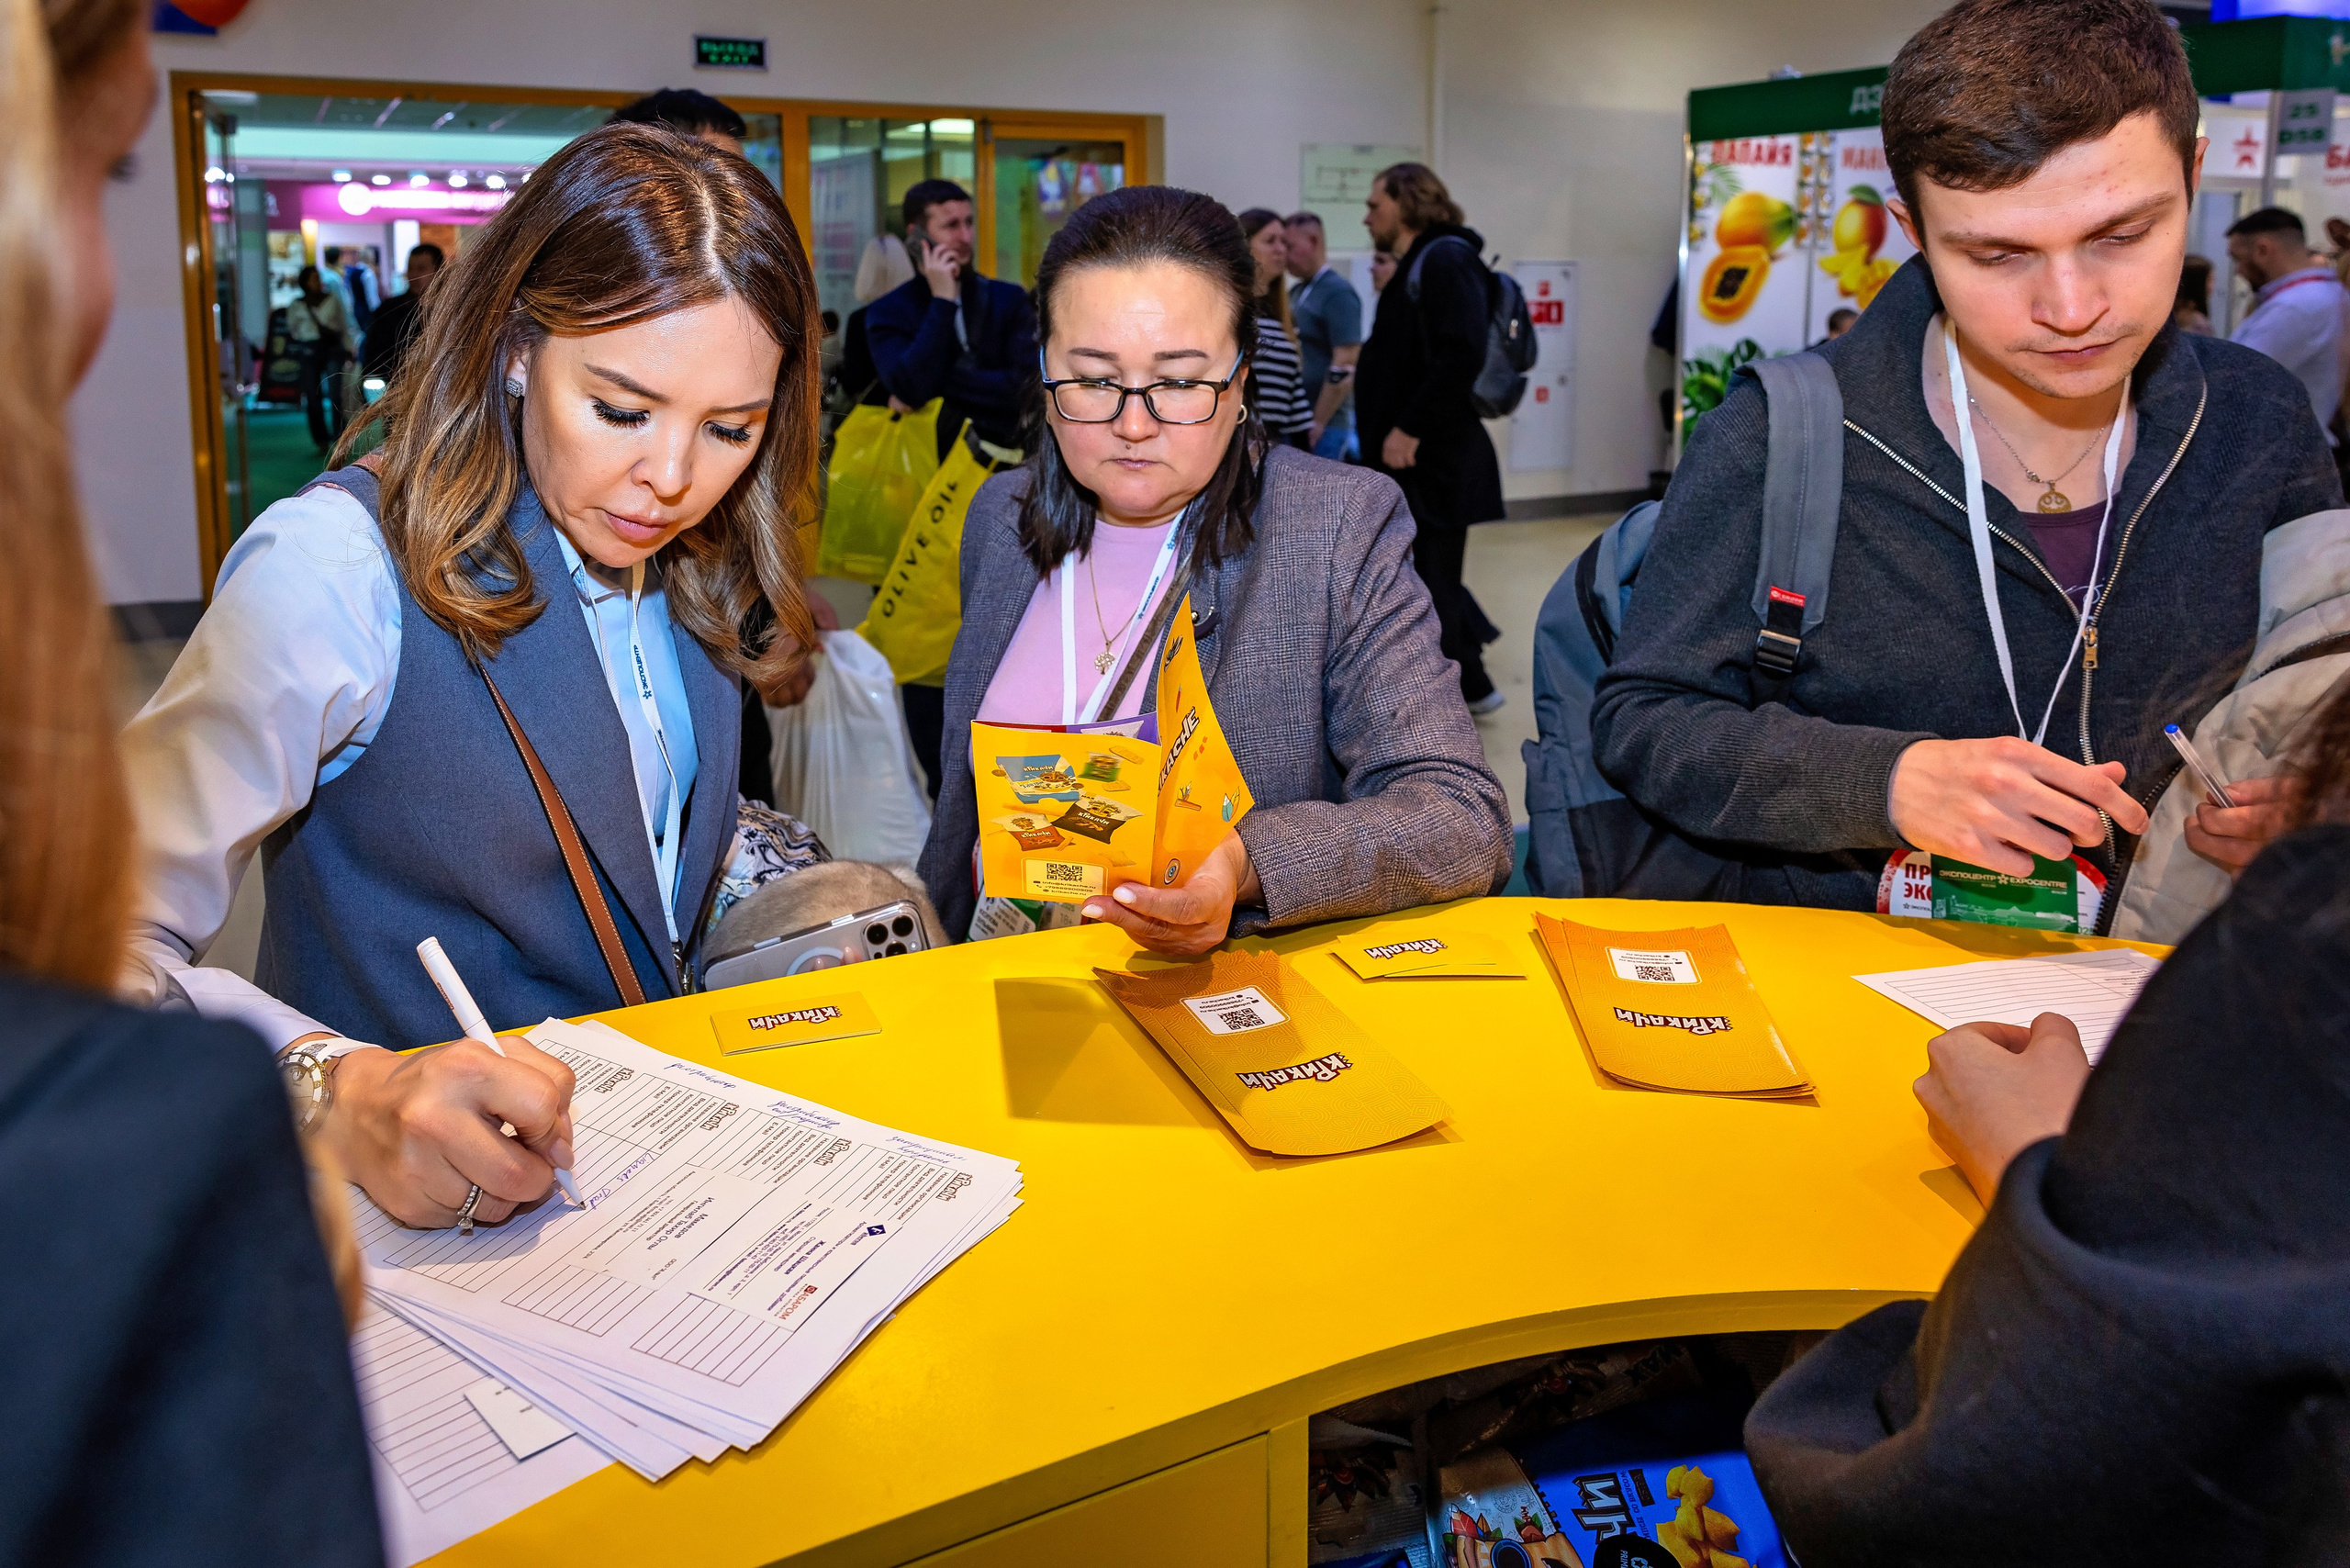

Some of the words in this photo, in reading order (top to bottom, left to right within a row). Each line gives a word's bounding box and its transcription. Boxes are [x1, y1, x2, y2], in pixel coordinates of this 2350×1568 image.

[882, 532, 930, 617] OLIVE
[931, 481, 958, 524] OIL
[633, 644, 649, 689] ЭКСПОЦЕНТР
[1158, 705, 1201, 796] IKACHE
[1939, 870, 1997, 880] ЭКСПОЦЕНТР
[2009, 877, 2067, 889] EXPOCENTRE
[586, 1066, 614, 1085] Название
[652, 1085, 671, 1099] E-Mail
[661, 1090, 682, 1103] Номер
[691, 1097, 707, 1106] Вид
[630, 1103, 665, 1127] телефонные
[662, 1093, 694, 1117] Контактное
[690, 1101, 718, 1122] Название
[648, 1116, 666, 1127] лицо
[657, 1105, 695, 1134] деятельности
[760, 1121, 779, 1135] E-Mail
[656, 1121, 693, 1149] организации
[770, 1126, 791, 1140] Номер
[773, 1129, 804, 1154] Контактное
[802, 1133, 817, 1143] Вид
[741, 1140, 774, 1166] телефонные
[770, 1142, 806, 1170] деятельности
[803, 1137, 830, 1158] Название
[759, 1153, 777, 1165] лицо
[877, 1155, 895, 1169] E-Mail
[889, 1159, 908, 1173] Номер
[771, 1157, 807, 1183] организации
[891, 1163, 922, 1188] Контактное
[921, 1167, 936, 1177] Вид
[861, 1173, 892, 1200] телефонные
[892, 1176, 925, 1205] деятельности
[924, 1171, 950, 1193] Название
[880, 1187, 897, 1199] лицо
[682, 1196, 715, 1219] Ингилаб
[895, 1192, 927, 1220] организации
[664, 1218, 688, 1236] Тахир
[673, 1213, 709, 1238] Мамедов
[645, 1235, 669, 1250] Оглы
